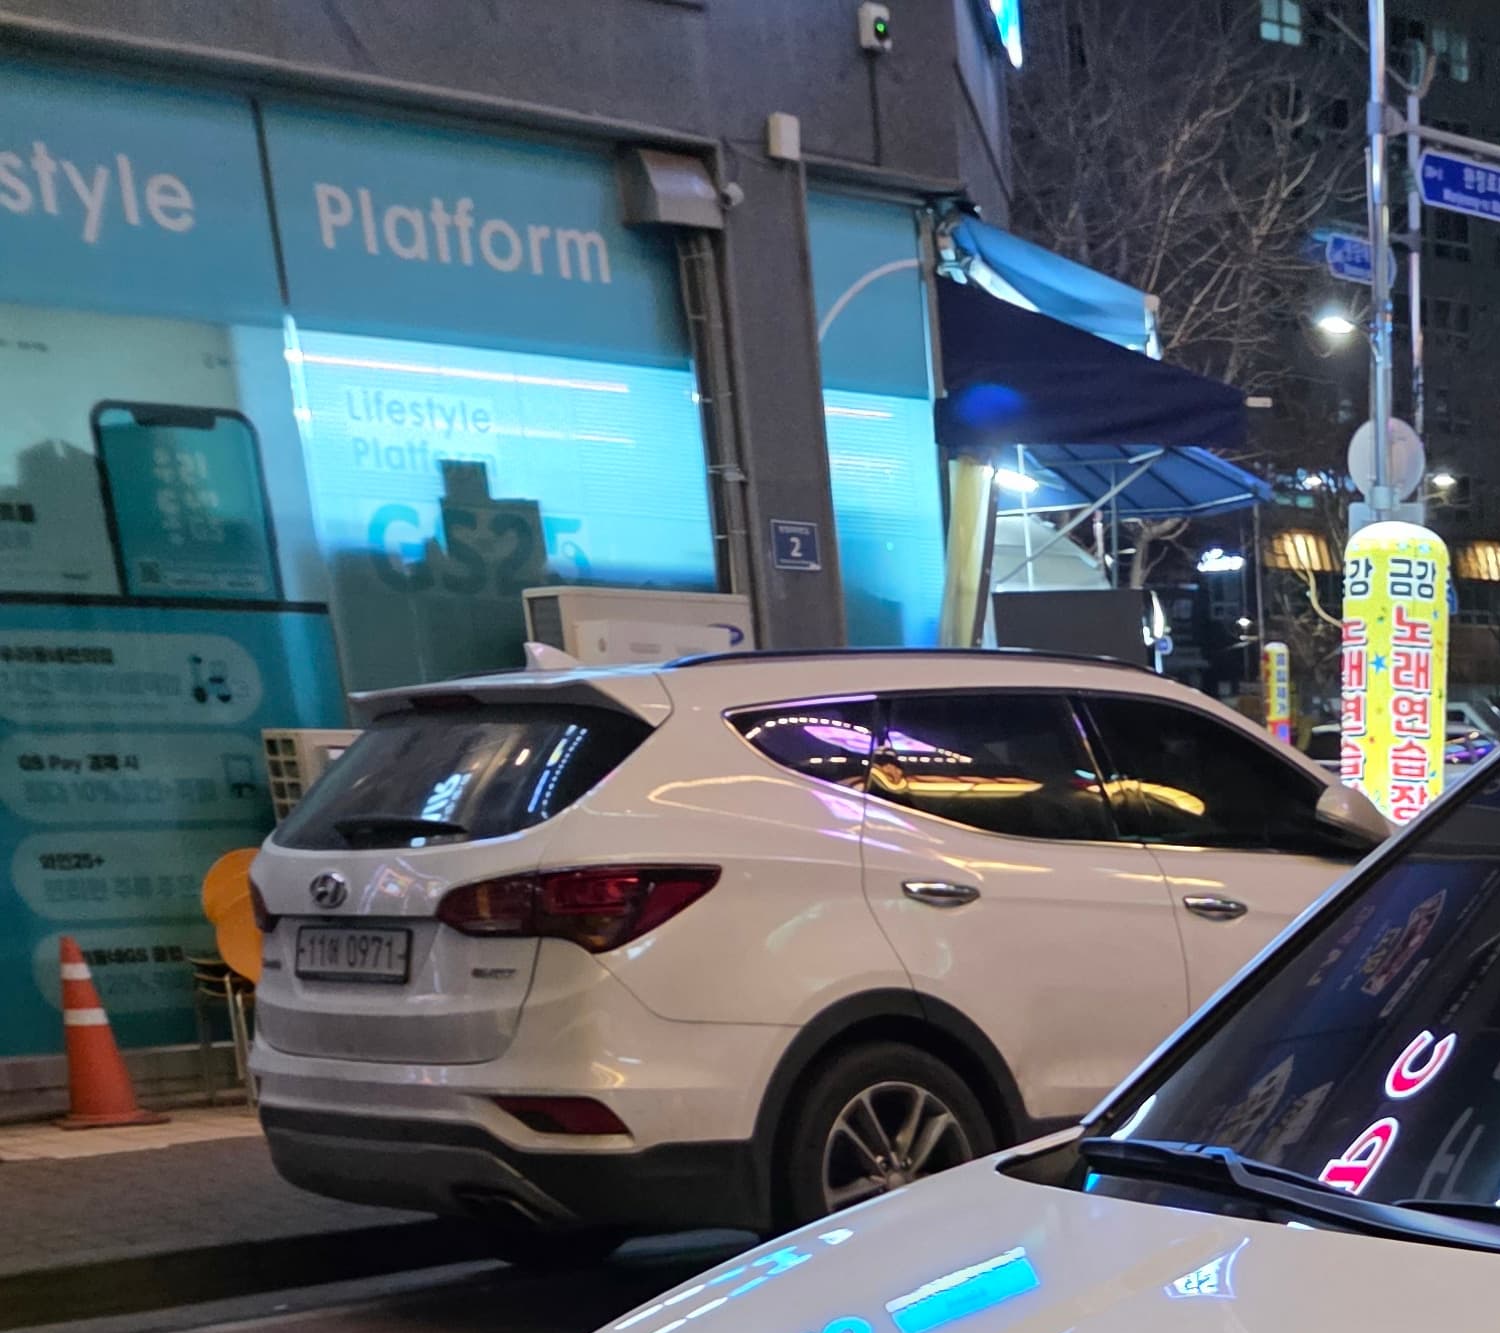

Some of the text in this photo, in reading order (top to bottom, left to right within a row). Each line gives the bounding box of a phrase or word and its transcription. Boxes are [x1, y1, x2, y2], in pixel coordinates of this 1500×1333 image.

[0, 142, 612, 284] style Platform
[347, 388, 492, 438] Lifestyle
[368, 503, 593, 594] GS25
[789, 536, 803, 557] 2
[1389, 558, 1437, 599] 금강
[1390, 604, 1433, 822] 노래연습장
[346, 935, 393, 969] 0971
